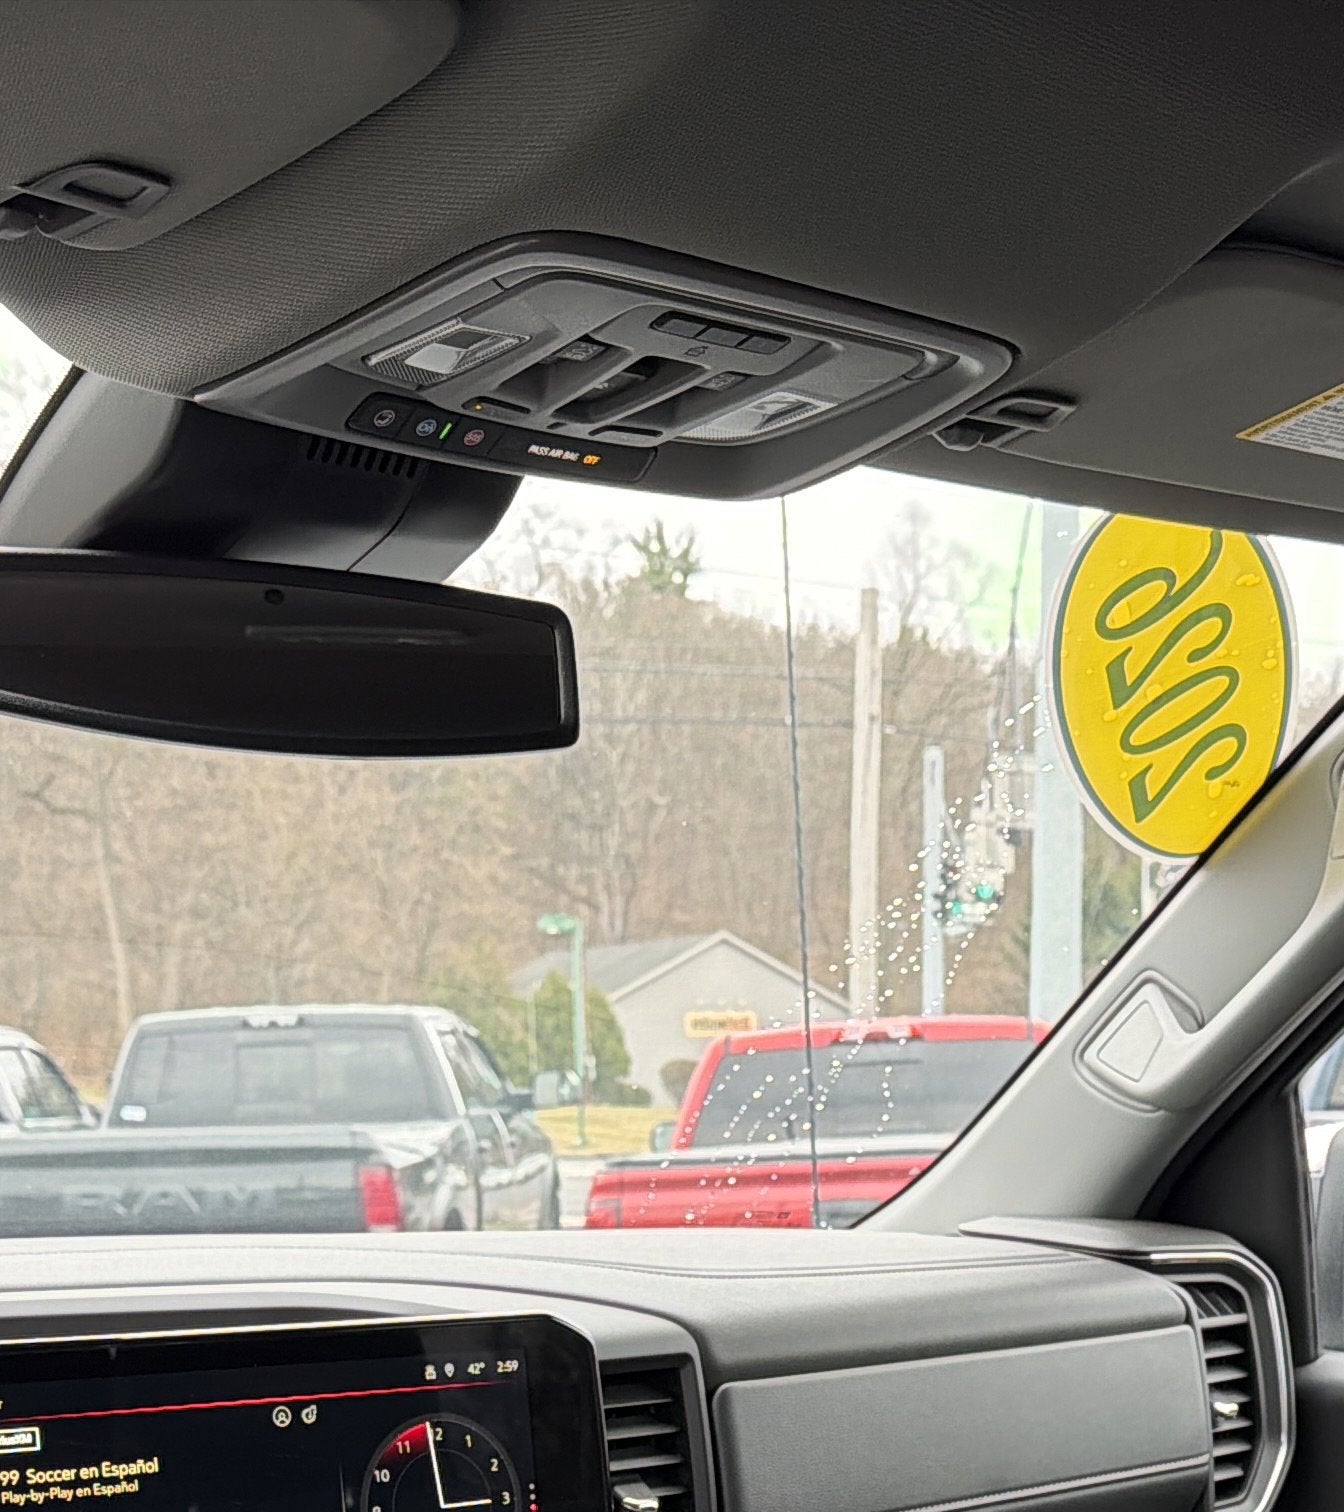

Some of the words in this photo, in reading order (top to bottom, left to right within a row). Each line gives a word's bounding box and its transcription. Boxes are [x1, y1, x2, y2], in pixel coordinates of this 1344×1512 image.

[527, 444, 552, 458] PASS
[551, 448, 564, 460] AIR
[562, 450, 580, 462] BAG
[582, 454, 602, 466] OFF
[466, 1361, 486, 1375] 42°
[496, 1359, 520, 1373] 2:59
[396, 1440, 411, 1455] 11
[464, 1435, 473, 1448] 1
[25, 1465, 77, 1485] Soccer
[79, 1466, 99, 1480] en
[101, 1456, 160, 1480] Español
[490, 1458, 499, 1472] 2
[373, 1468, 391, 1483] 10
[1, 1486, 74, 1507] Play-by-Play
[75, 1485, 92, 1497] en
[93, 1479, 139, 1499] Español
[501, 1491, 511, 1505] 3
